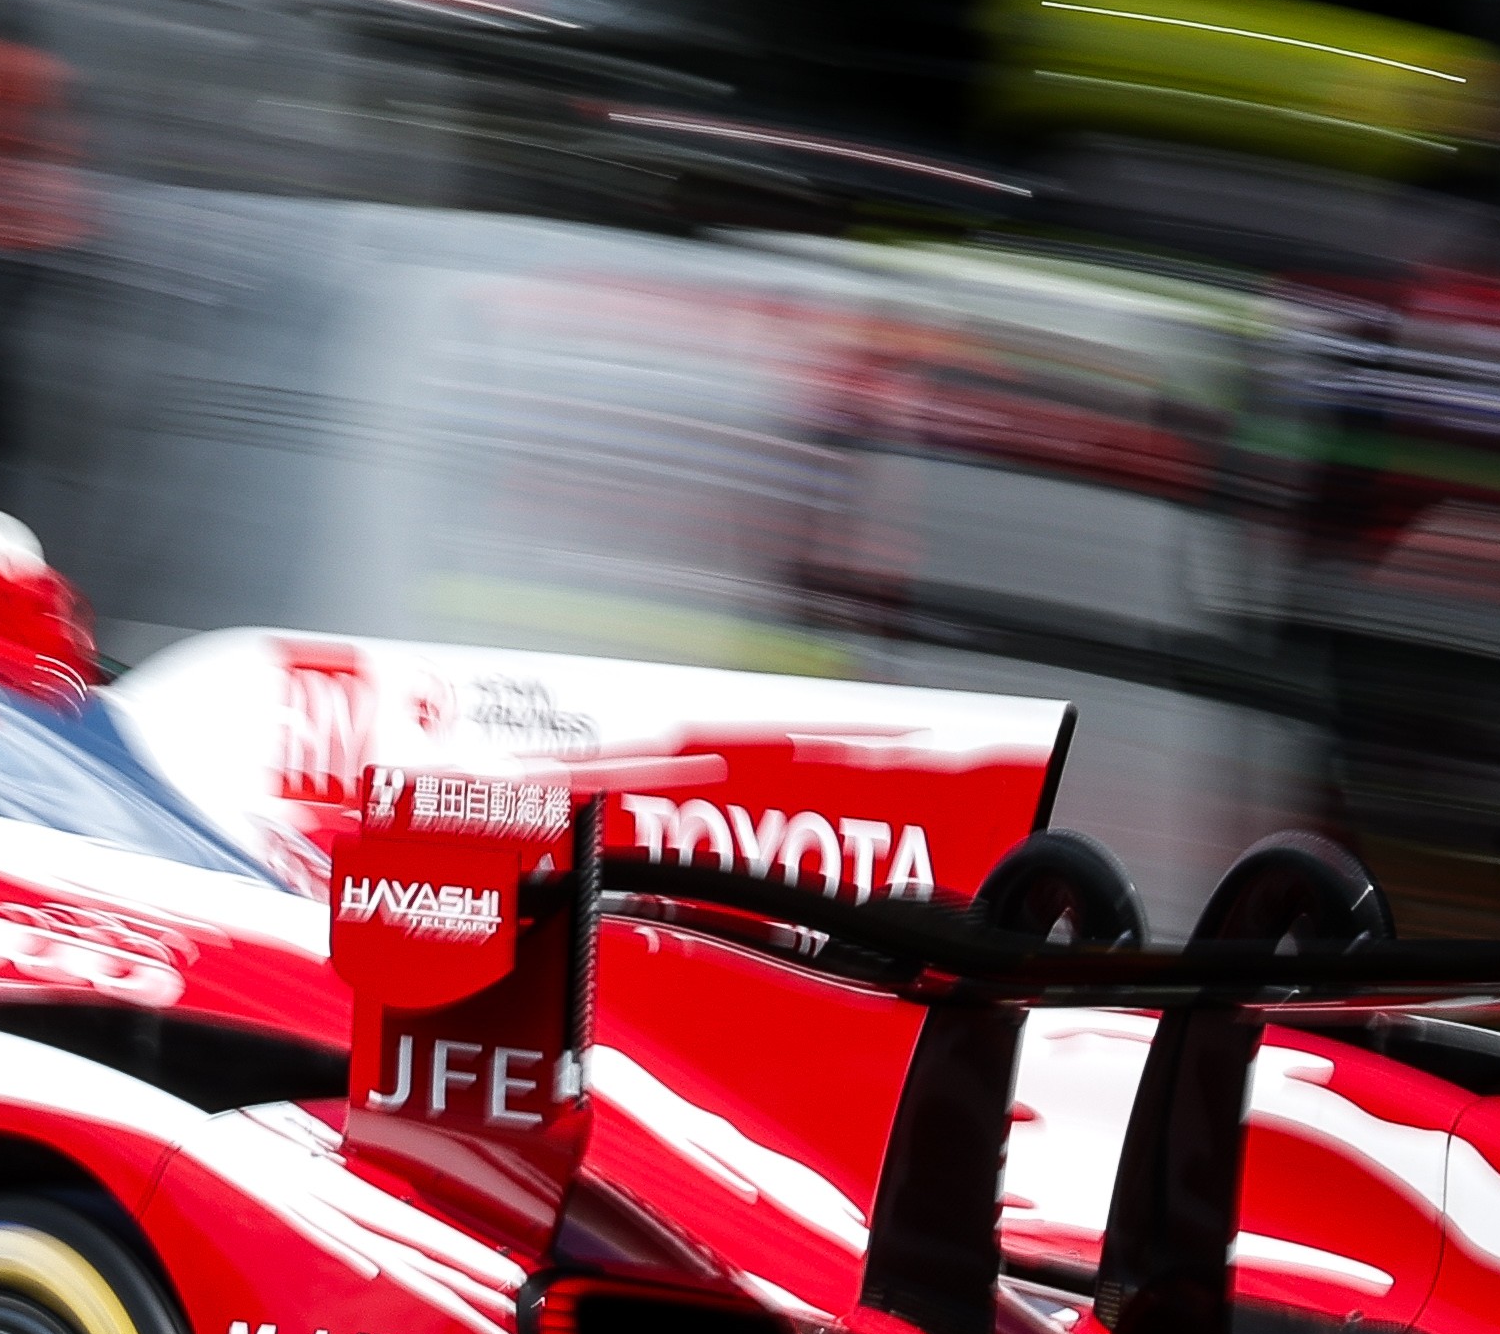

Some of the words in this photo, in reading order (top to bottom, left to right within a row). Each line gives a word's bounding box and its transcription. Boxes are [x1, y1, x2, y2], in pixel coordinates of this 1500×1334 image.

[411, 775, 571, 831] 豊田自動織機
[620, 793, 935, 906] TOYOTA
[341, 876, 502, 917] HAYASHI
[366, 1035, 543, 1125] JFE
